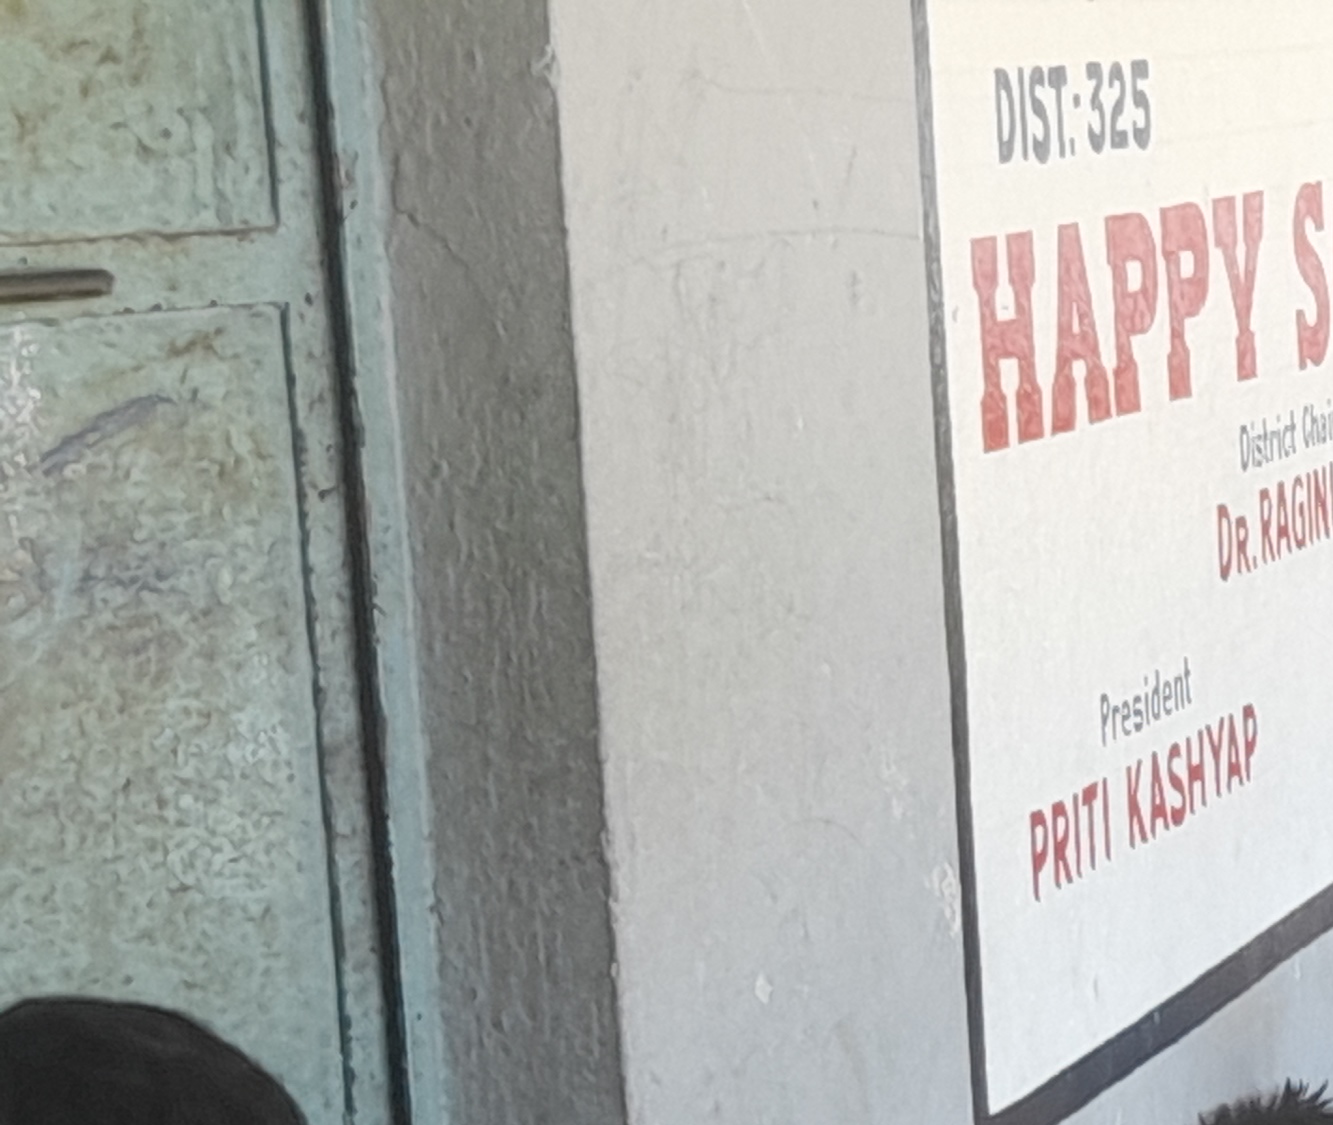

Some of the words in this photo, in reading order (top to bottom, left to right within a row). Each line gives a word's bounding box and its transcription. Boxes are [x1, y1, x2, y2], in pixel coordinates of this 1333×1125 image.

[970, 190, 1264, 453] HAPPY
[1239, 410, 1296, 473] District
[1100, 656, 1192, 747] President
[1029, 776, 1111, 902] PRITI
[1126, 702, 1258, 849] KASHYAP
